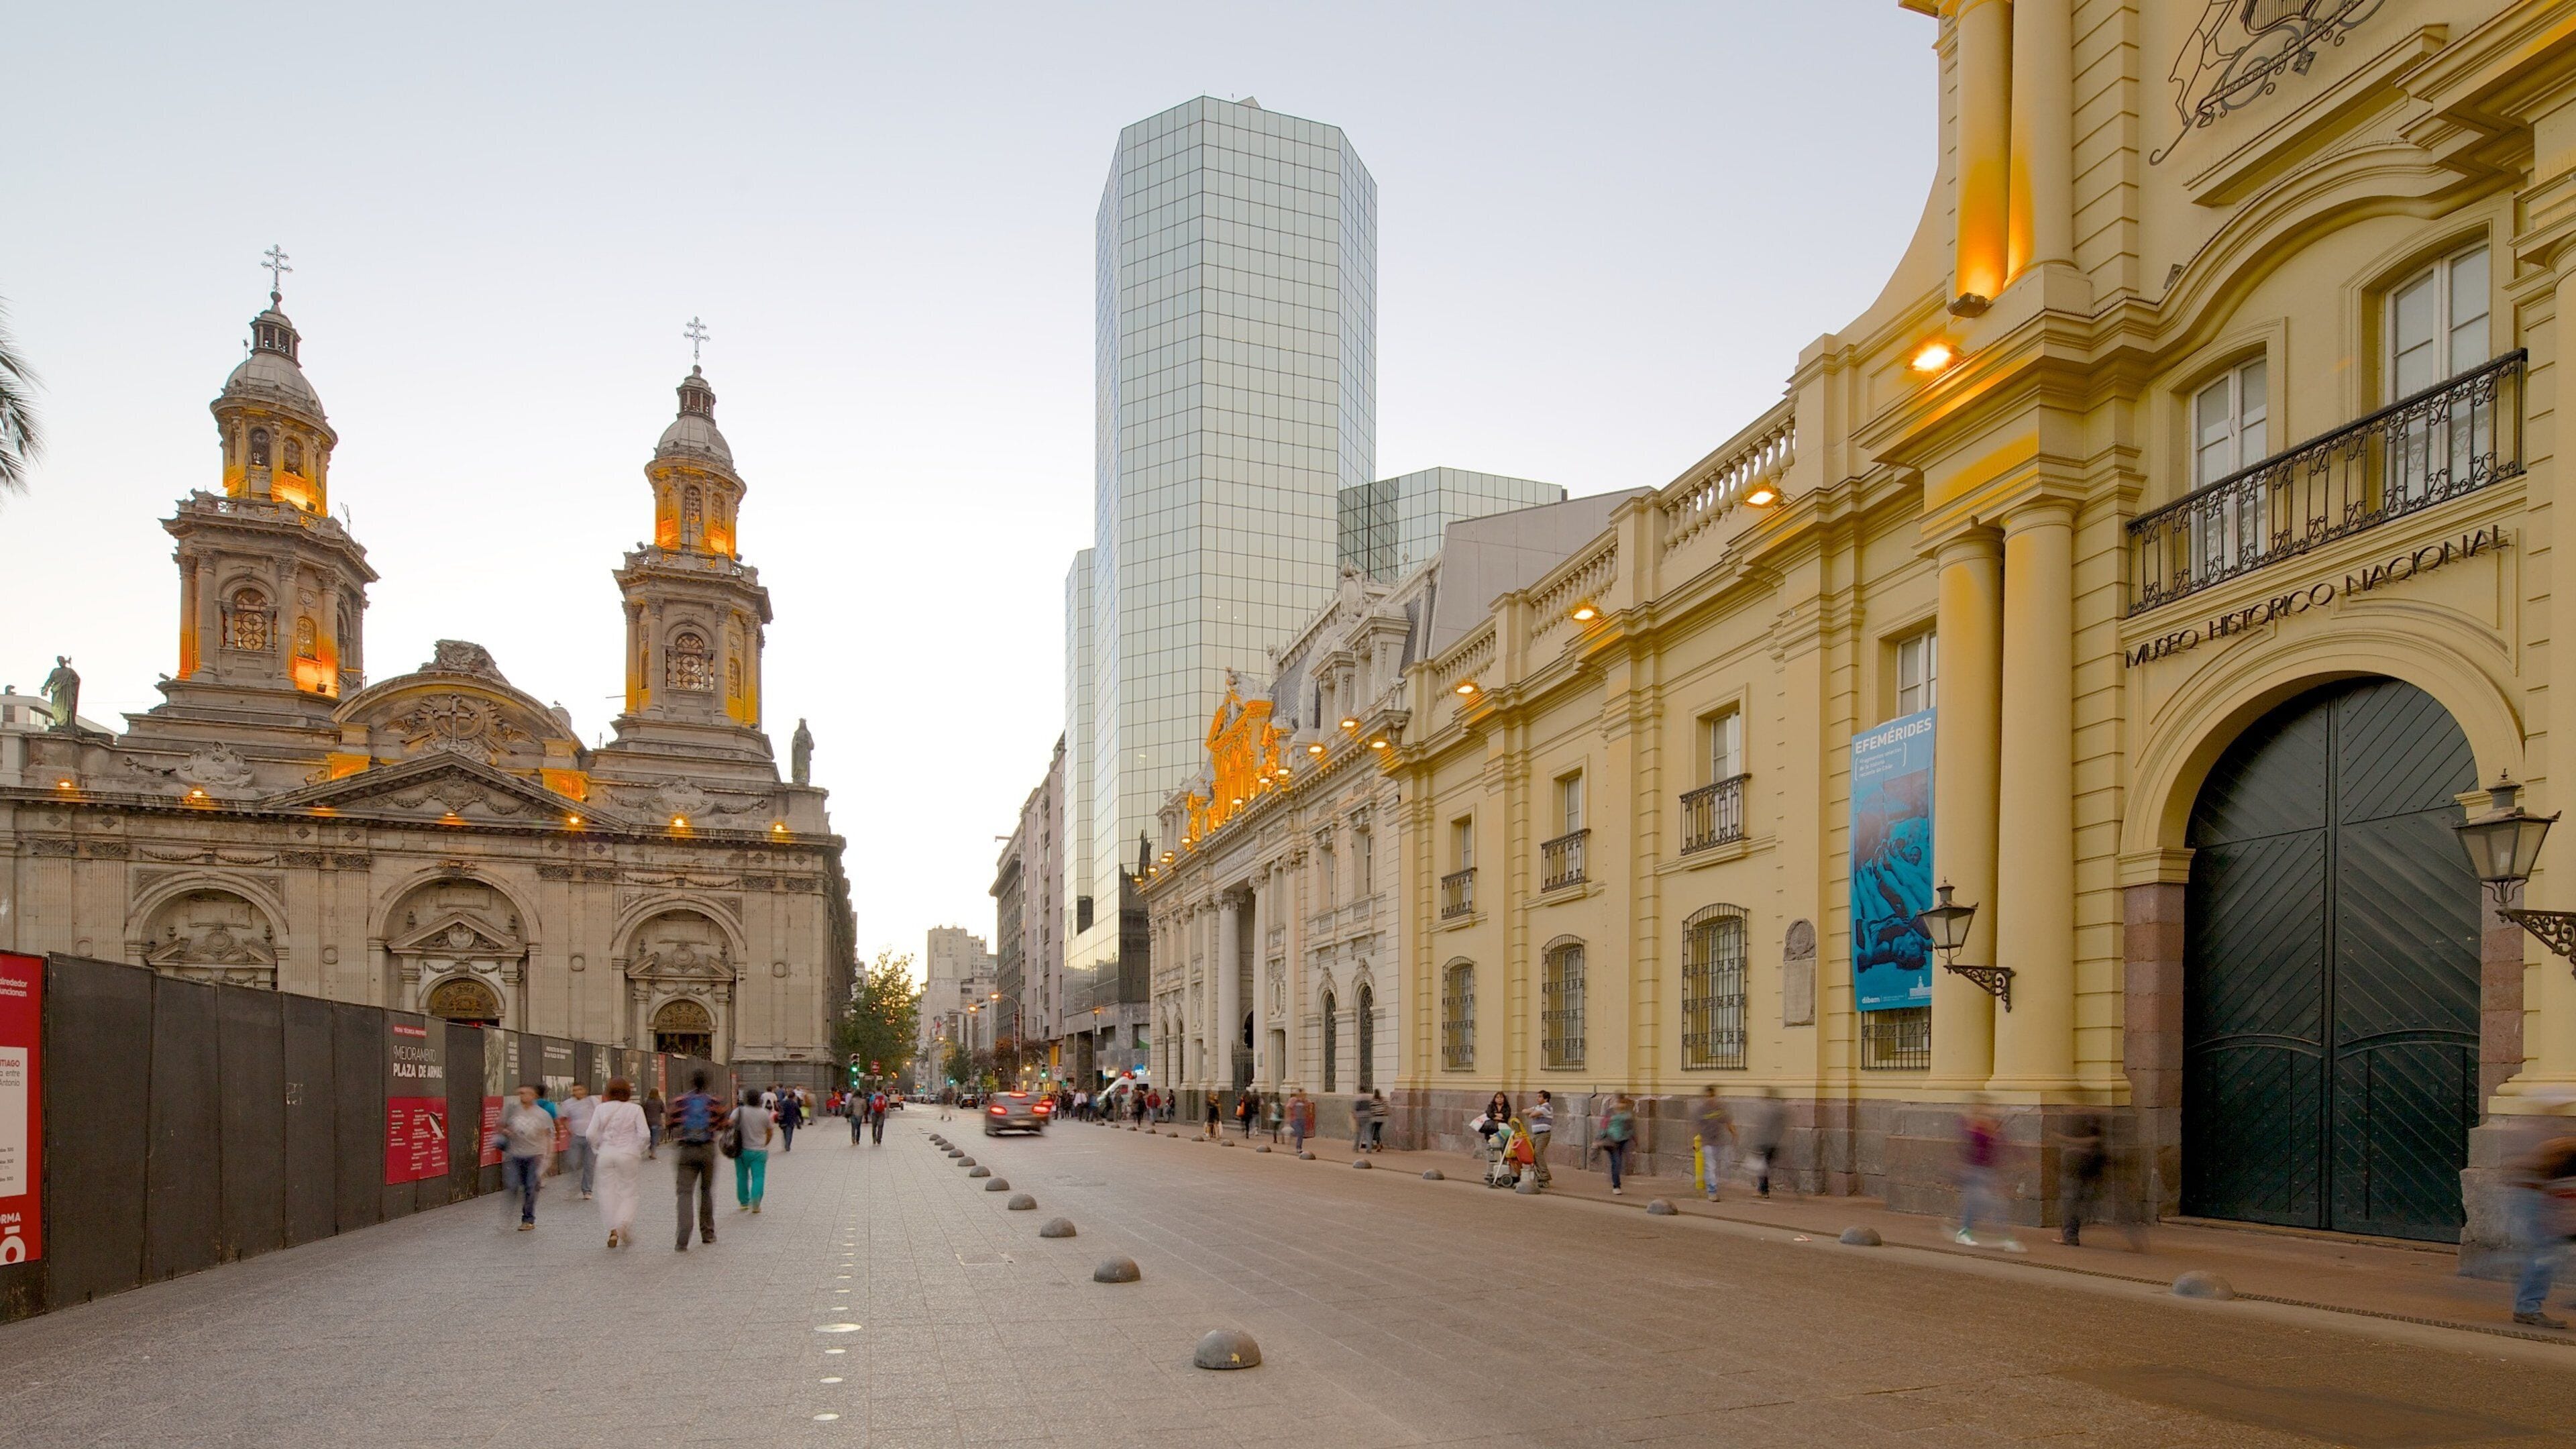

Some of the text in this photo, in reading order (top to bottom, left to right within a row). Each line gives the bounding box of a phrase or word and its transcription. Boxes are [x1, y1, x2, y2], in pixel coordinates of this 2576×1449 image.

[2125, 525, 2508, 669] MUSEO HISTORICO NACIONAL
[1856, 717, 1932, 754] EFEMÉRIDES
[393, 1063, 443, 1078] PLAZA DE ARMAS
